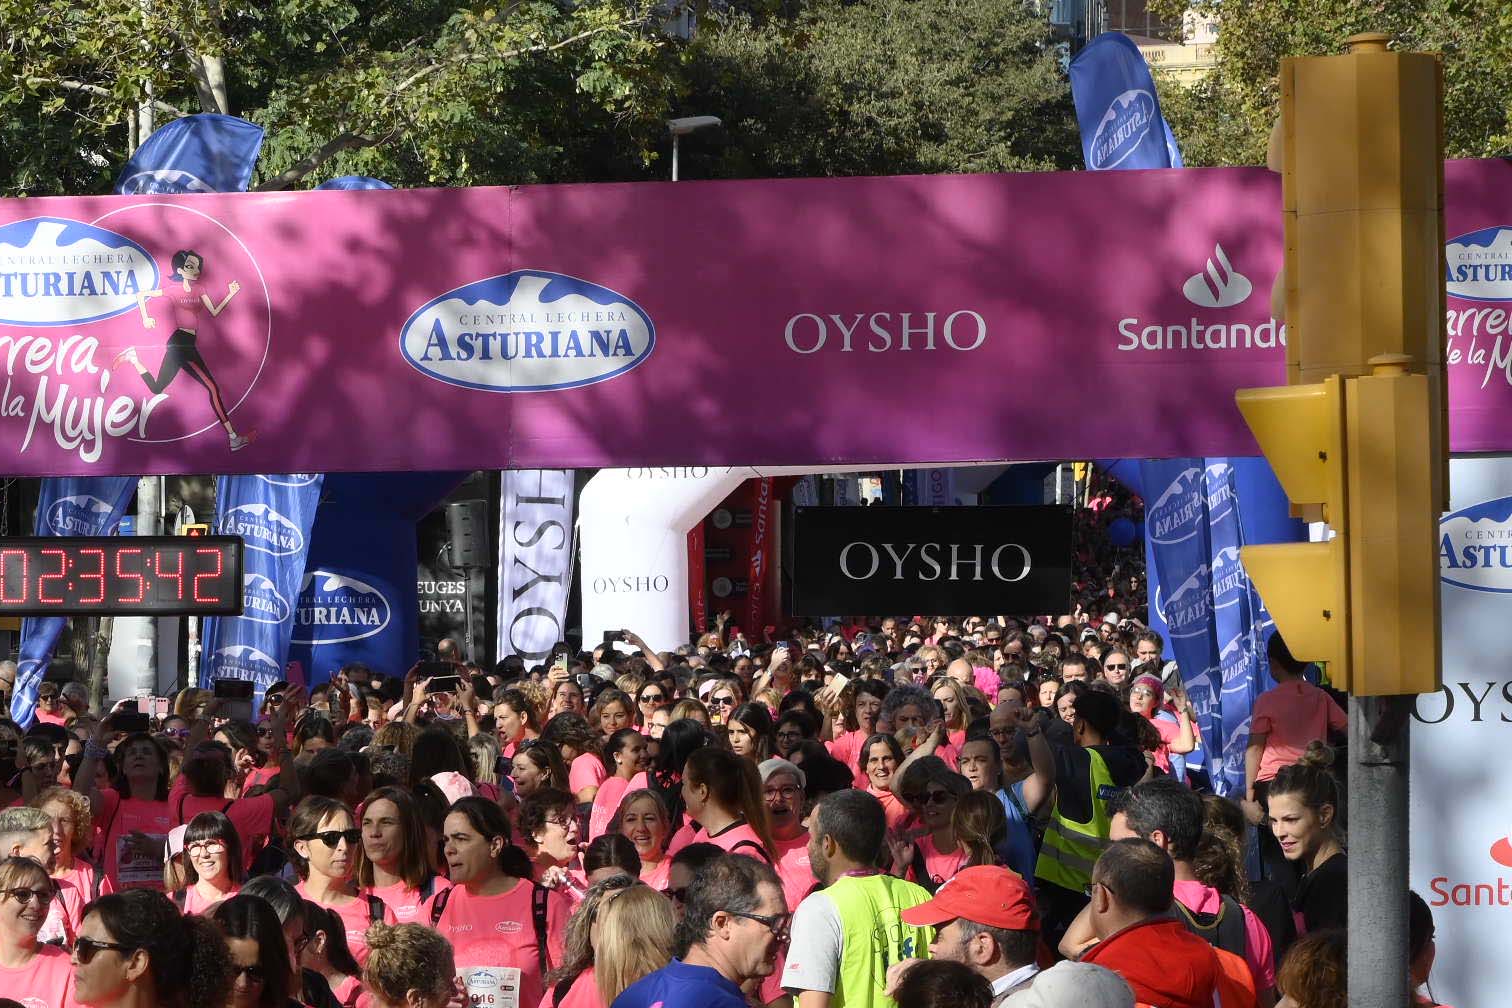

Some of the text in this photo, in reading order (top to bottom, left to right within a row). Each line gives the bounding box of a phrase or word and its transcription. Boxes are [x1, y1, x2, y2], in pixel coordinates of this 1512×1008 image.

[61, 254, 134, 265] LECHERA
[459, 311, 626, 325] CENTRAL LECHERA
[784, 310, 986, 354] OYSHO
[420, 317, 635, 362] ASTURIANA
[1117, 317, 1287, 351] Santand
[1467, 338, 1486, 365] la
[0, 379, 25, 417] la
[21, 367, 169, 462] Mujer
[1465, 530, 1512, 539] CENTR
[0, 549, 221, 603] 02:35:42
[509, 469, 566, 660] OYSH
[839, 541, 1032, 582] OYSHO
[417, 581, 466, 594] EUGES
[593, 574, 669, 595] OYSHO
[295, 607, 380, 625] TURIANA
[419, 600, 464, 612] UNYA
[1410, 682, 1512, 723] OYS
